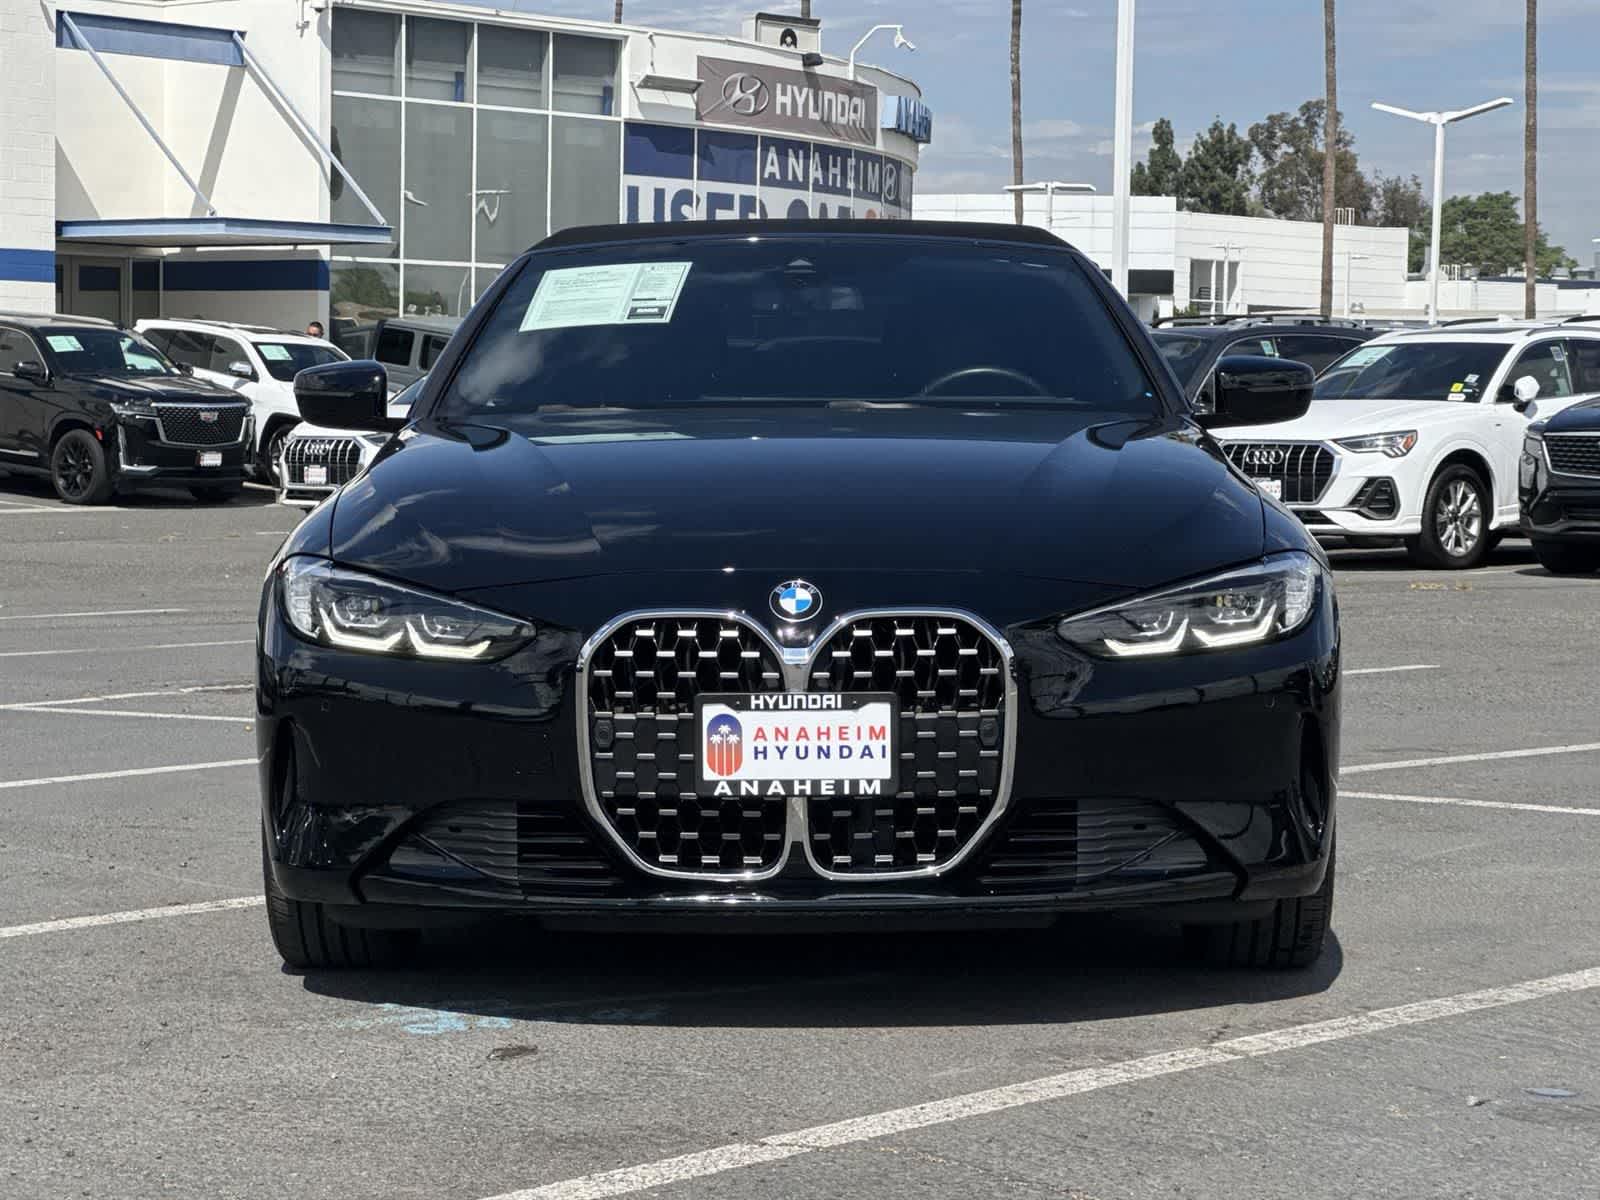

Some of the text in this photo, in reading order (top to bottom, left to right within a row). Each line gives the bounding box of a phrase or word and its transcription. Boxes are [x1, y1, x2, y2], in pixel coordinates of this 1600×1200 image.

[775, 83, 866, 129] HYUNDAI
[763, 146, 880, 193] ANAHEIM
[751, 695, 842, 709] HYUNDAI
[753, 726, 887, 742] ANAHEIM
[753, 745, 887, 760] HYUNDAI
[713, 780, 881, 796] ANAHEIM
